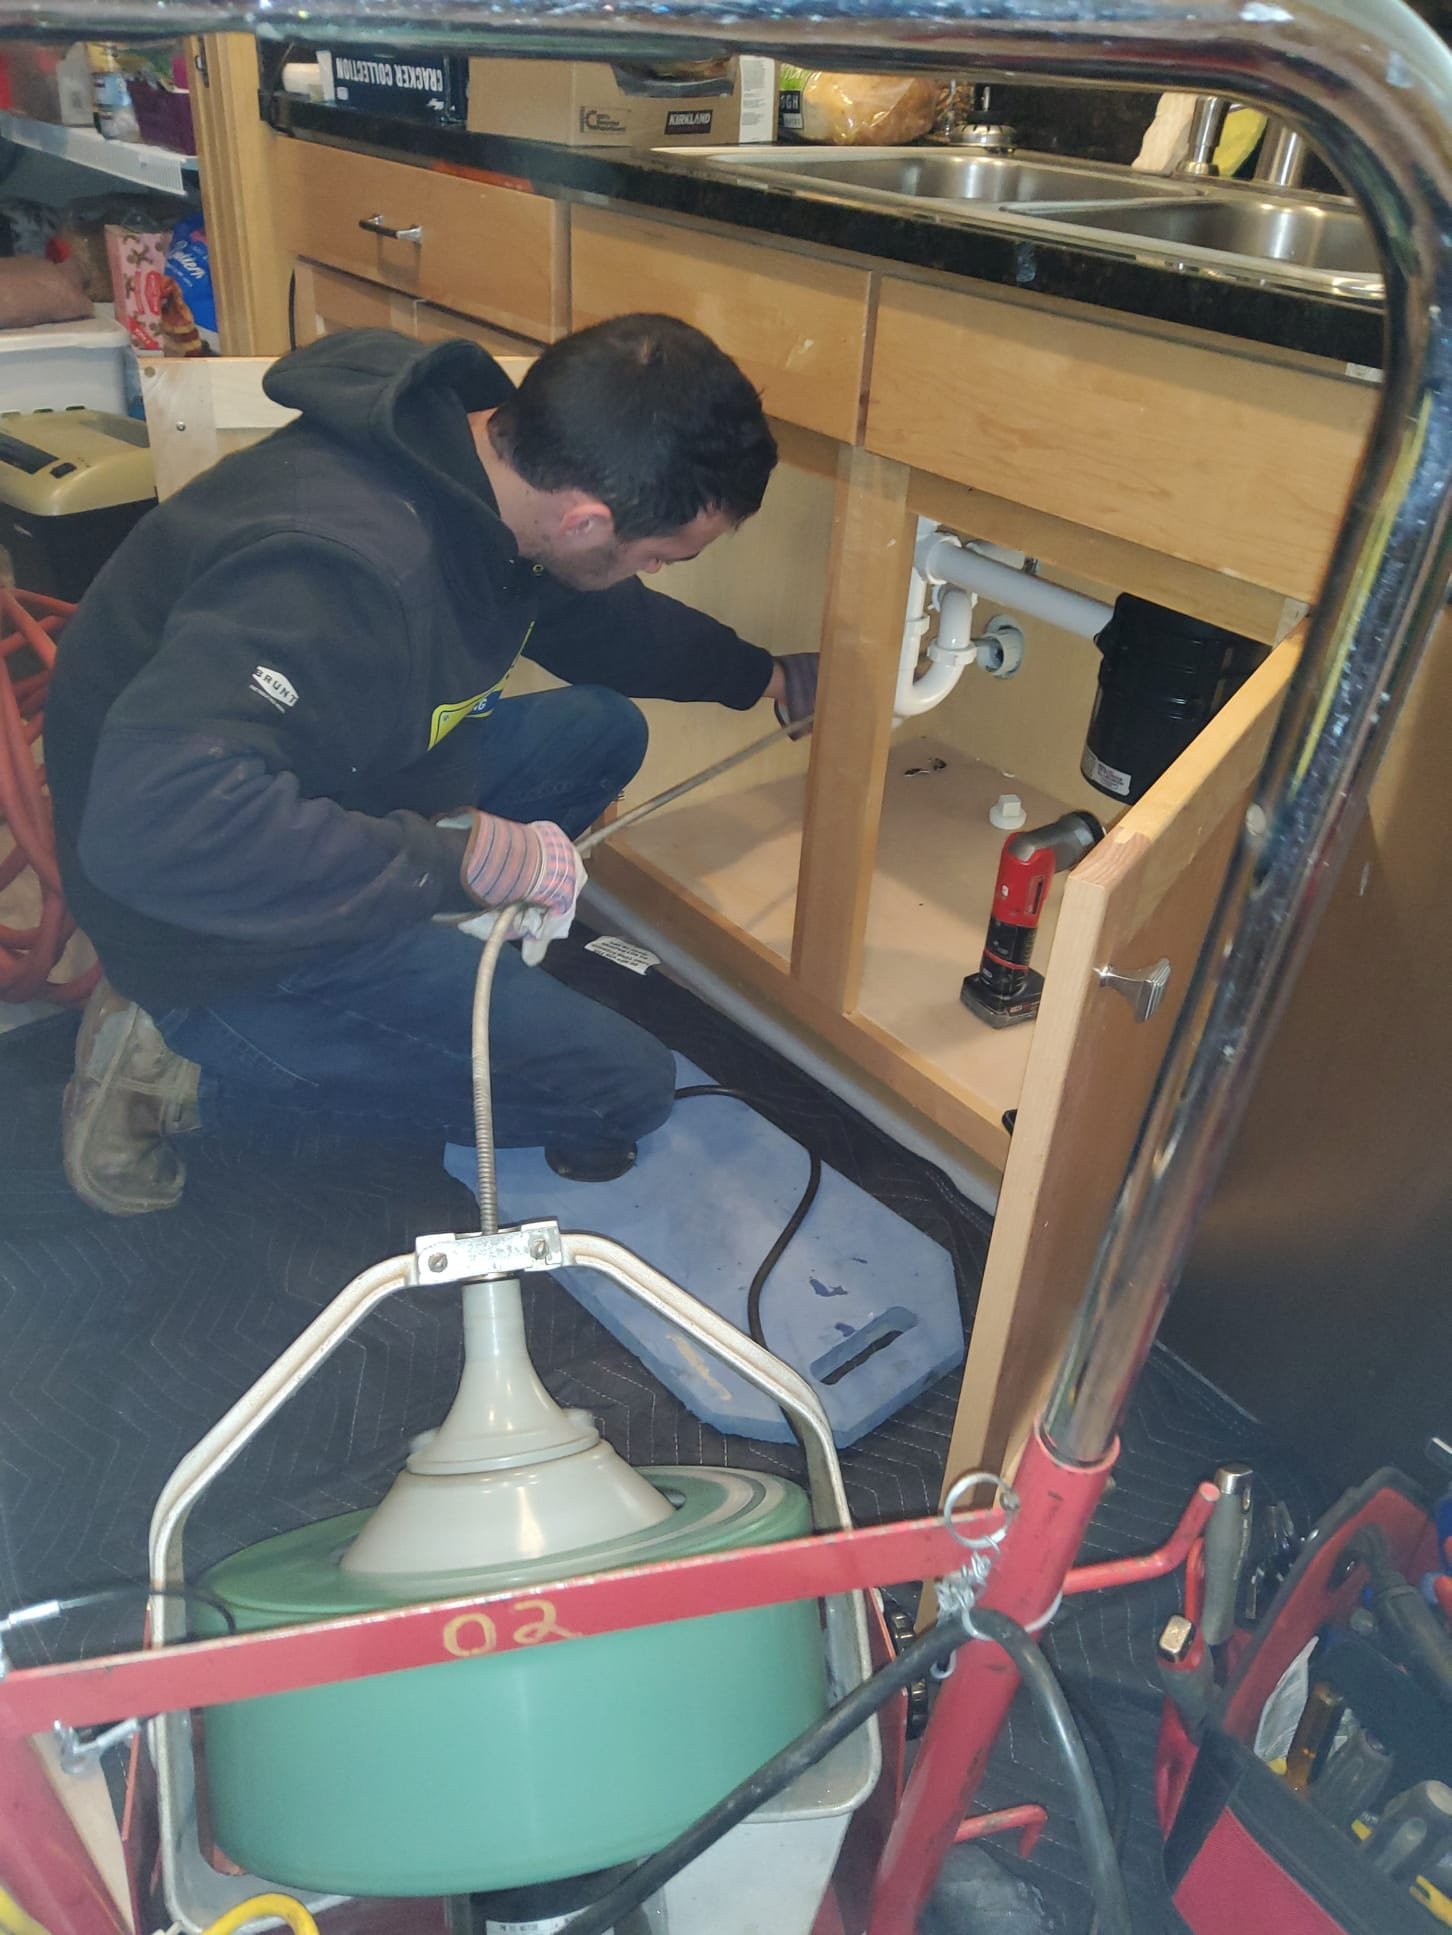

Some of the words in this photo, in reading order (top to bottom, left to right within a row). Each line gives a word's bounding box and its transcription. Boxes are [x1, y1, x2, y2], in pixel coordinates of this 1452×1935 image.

[335, 57, 393, 87] COLLECTION
[395, 63, 444, 92] CRACKER
[668, 112, 711, 126] KIRKLAND
[254, 667, 298, 706] BRUNT
